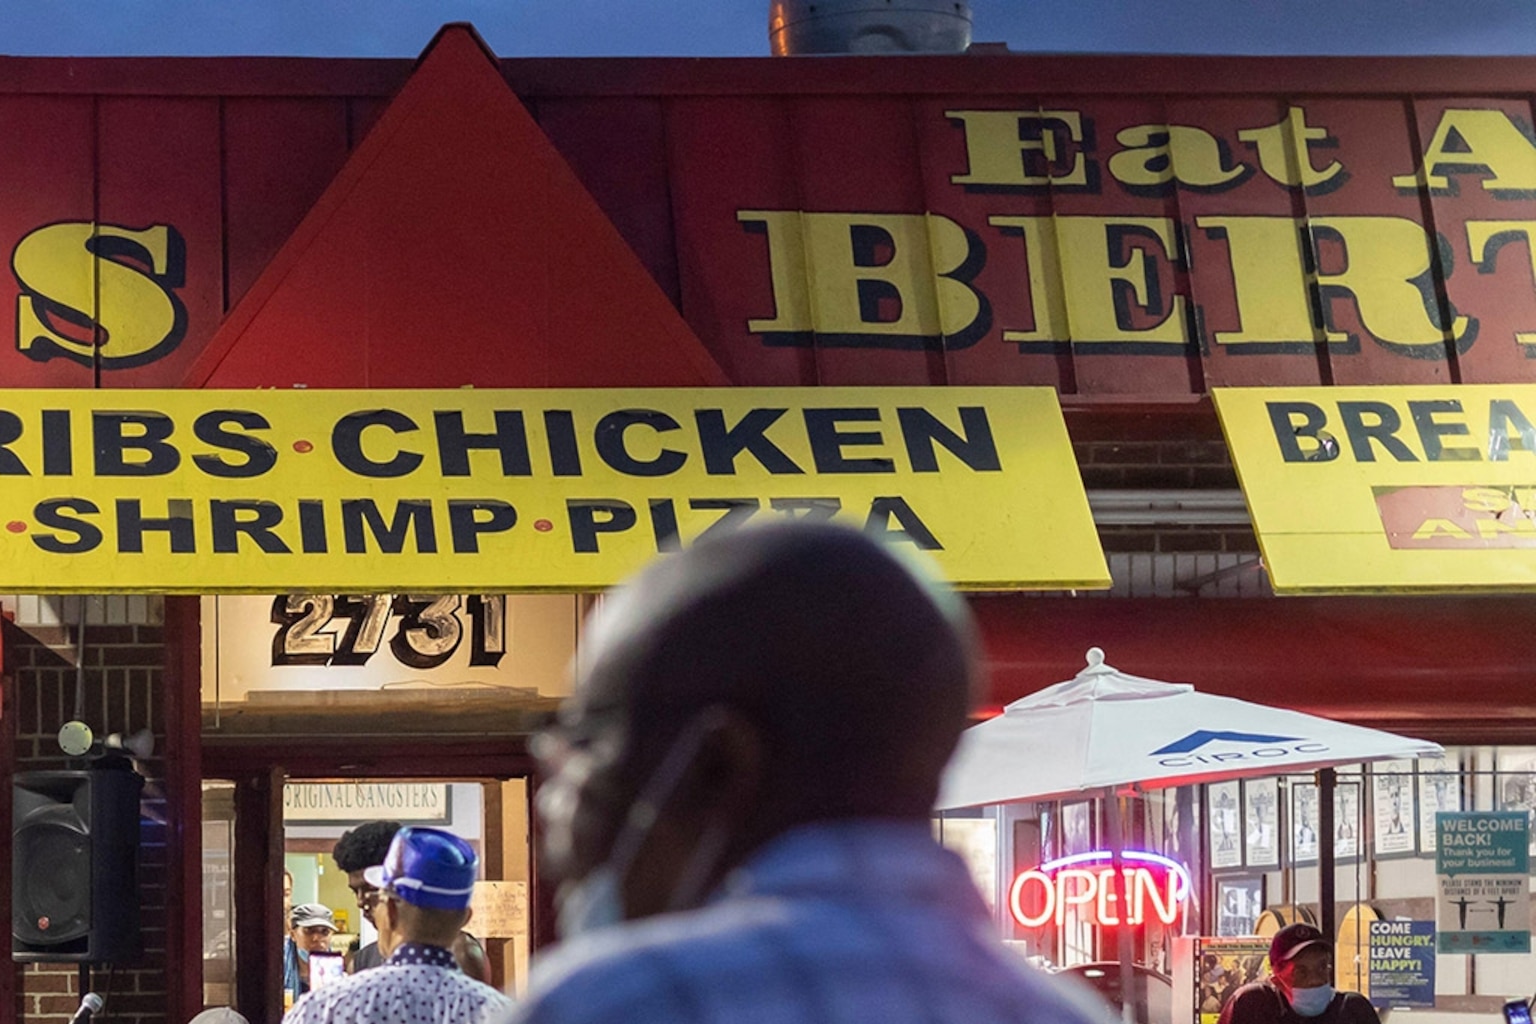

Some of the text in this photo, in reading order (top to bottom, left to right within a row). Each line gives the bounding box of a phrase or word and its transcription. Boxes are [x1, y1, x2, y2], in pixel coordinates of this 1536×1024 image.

[945, 106, 1351, 195] Eat
[330, 406, 1003, 478] CHICKEN
[30, 497, 518, 556] SHRIMP
[271, 594, 506, 669] 2731
[283, 784, 438, 808] ORIGINAL GANGSTERS
[1442, 819, 1524, 832] WELCOME
[1443, 833, 1492, 846] BACK!
[1443, 847, 1512, 858] Thank you for
[1442, 858, 1516, 869] your business!
[1010, 867, 1178, 927] OPEN
[1370, 922, 1412, 934] COME
[1370, 935, 1434, 947] HUNGRY.
[1370, 947, 1411, 959] LEAVE
[1370, 959, 1422, 971] HAPPY!
